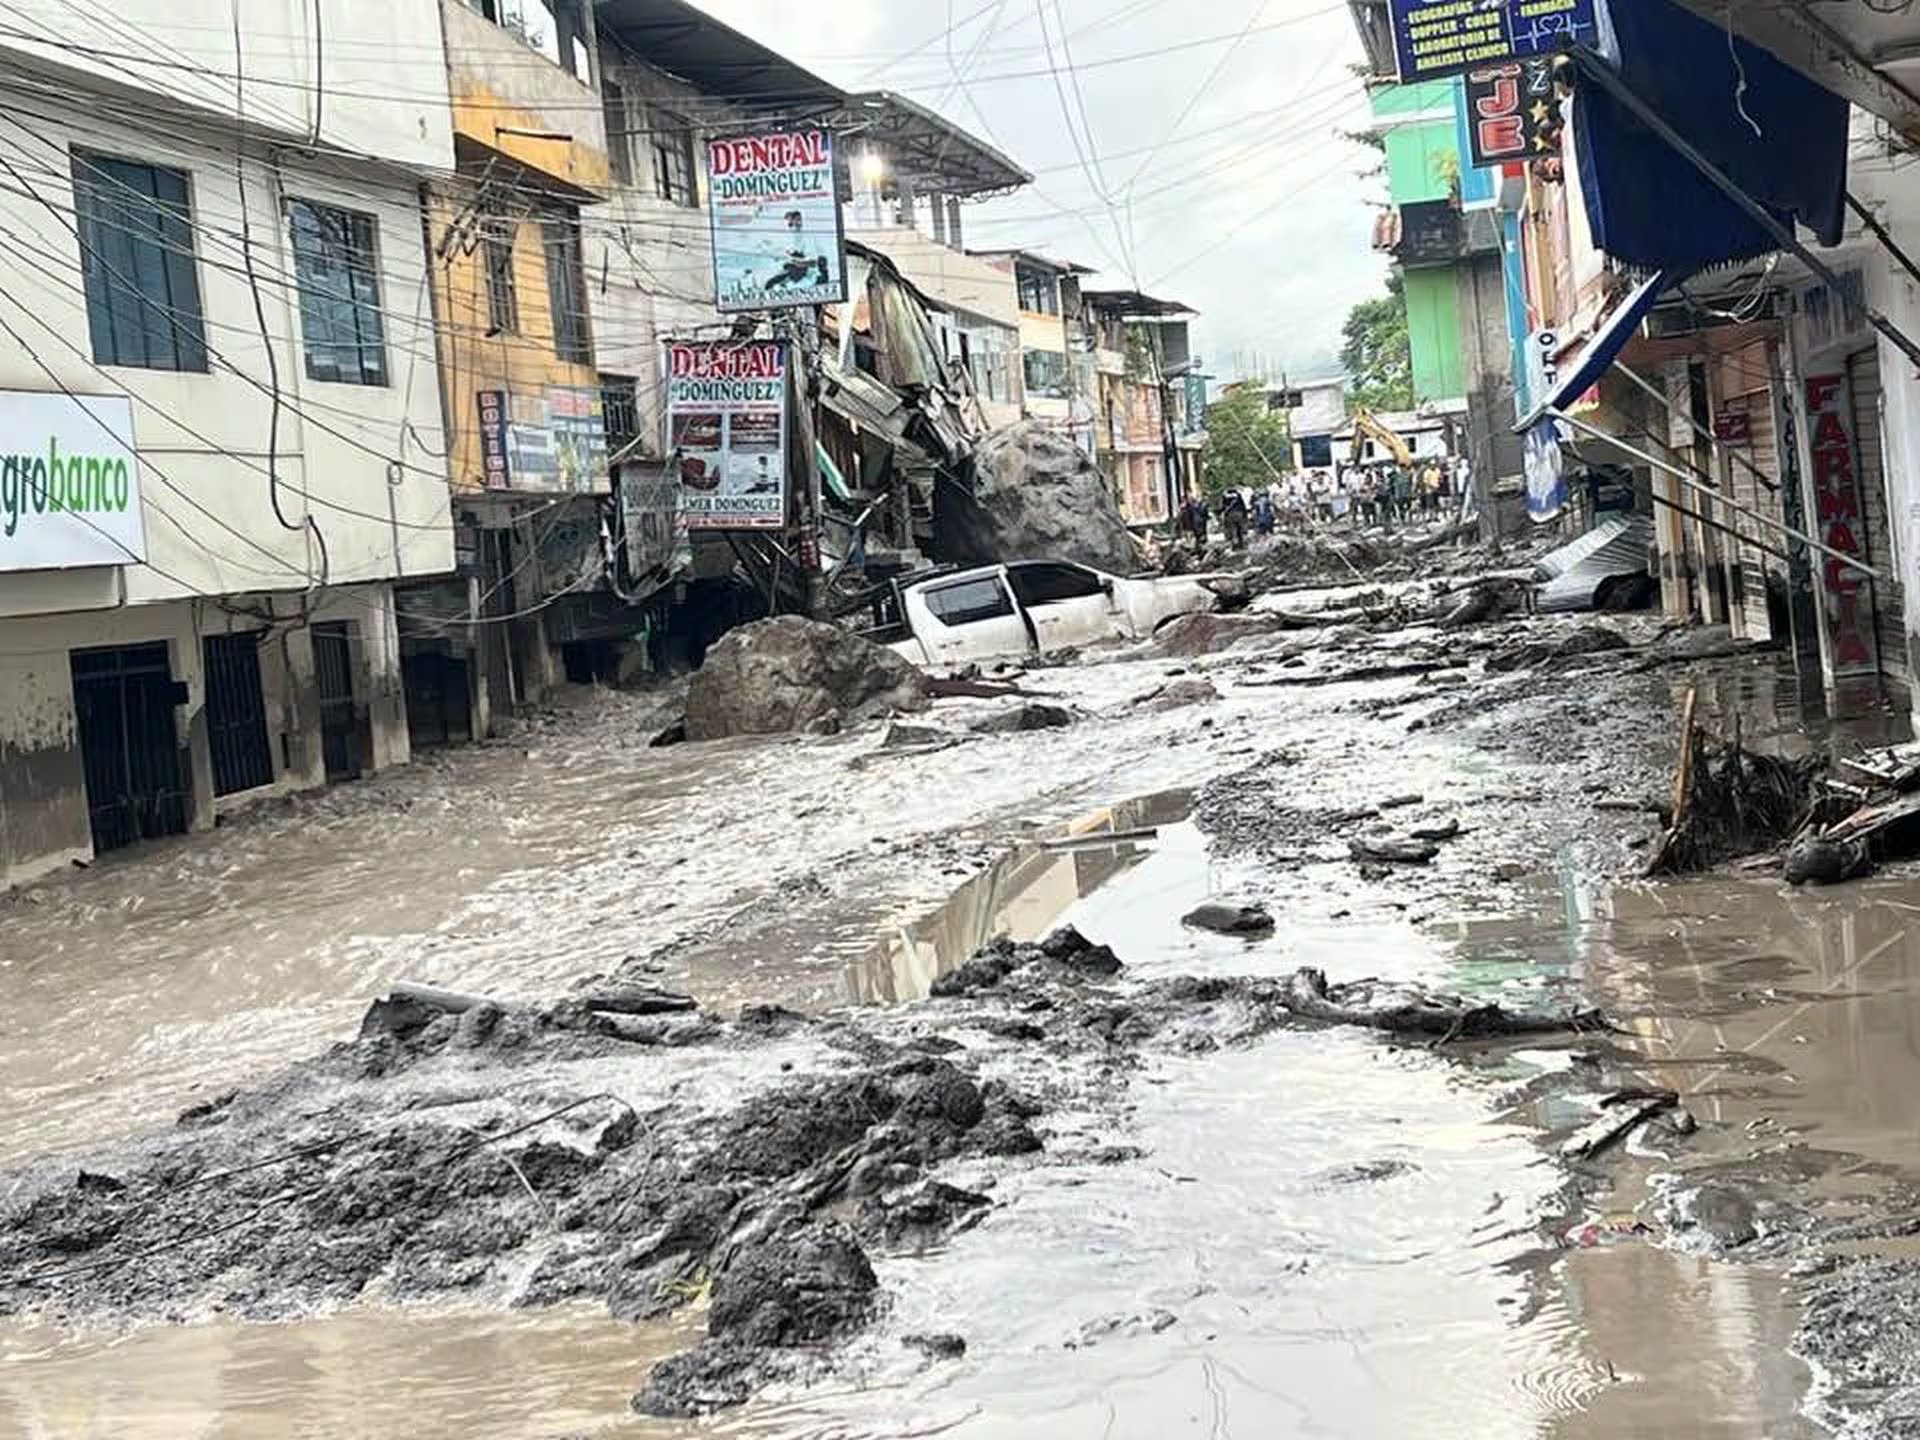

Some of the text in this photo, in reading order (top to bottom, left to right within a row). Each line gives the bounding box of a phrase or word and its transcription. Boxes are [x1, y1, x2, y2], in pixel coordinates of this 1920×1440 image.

[710, 131, 826, 175] DENTAL
[671, 346, 781, 378] DENTAL
[0, 435, 128, 537] grobanco
[715, 497, 781, 510] DOMINGUEZ
[1808, 375, 1872, 664] FARMACIA
